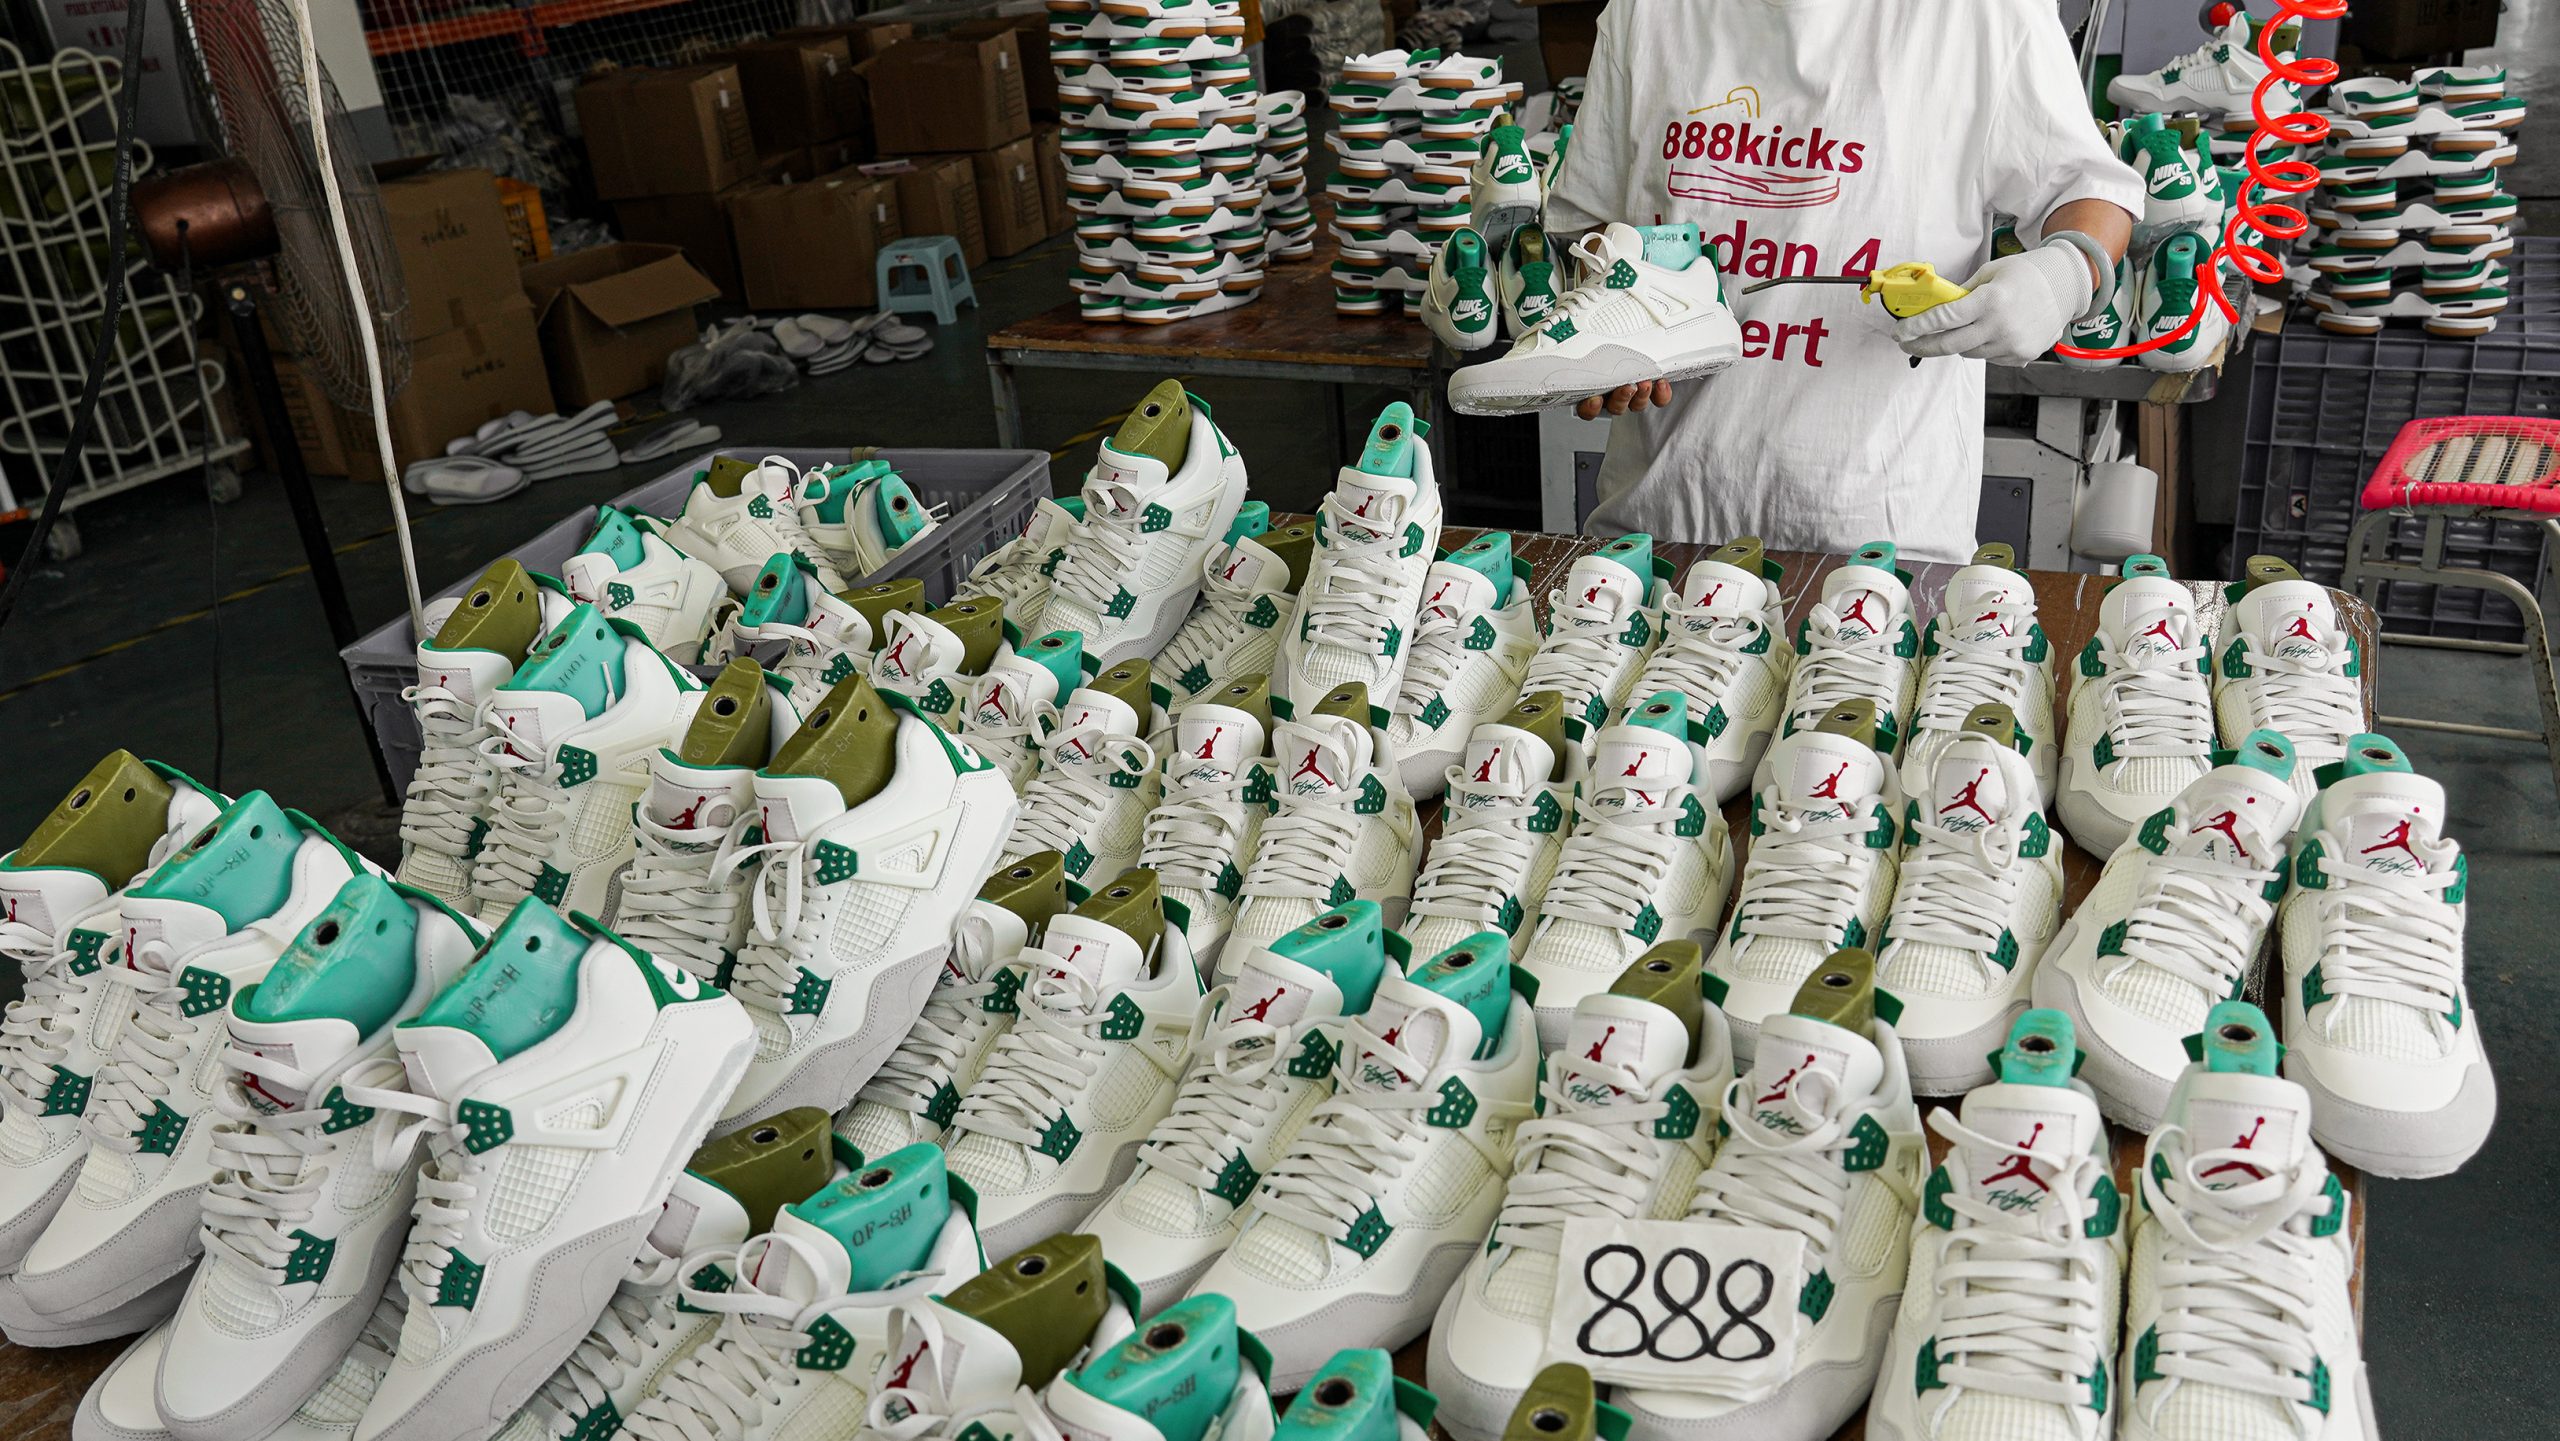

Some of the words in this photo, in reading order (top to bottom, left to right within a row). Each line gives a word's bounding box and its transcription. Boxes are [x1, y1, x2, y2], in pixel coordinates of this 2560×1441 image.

[1662, 120, 1864, 174] 888kicks
[1498, 154, 1523, 169] NIKE
[2153, 162, 2183, 183] NIKE
[2179, 175, 2192, 186] SB
[1841, 238, 1881, 291] 4
[1456, 299, 1483, 313] NIKE
[1523, 295, 1549, 309] NIKE
[1474, 311, 1488, 322] SB
[2098, 328, 2114, 340] SB
[1740, 317, 1829, 368] ert
[1577, 1244, 1776, 1361] 888
